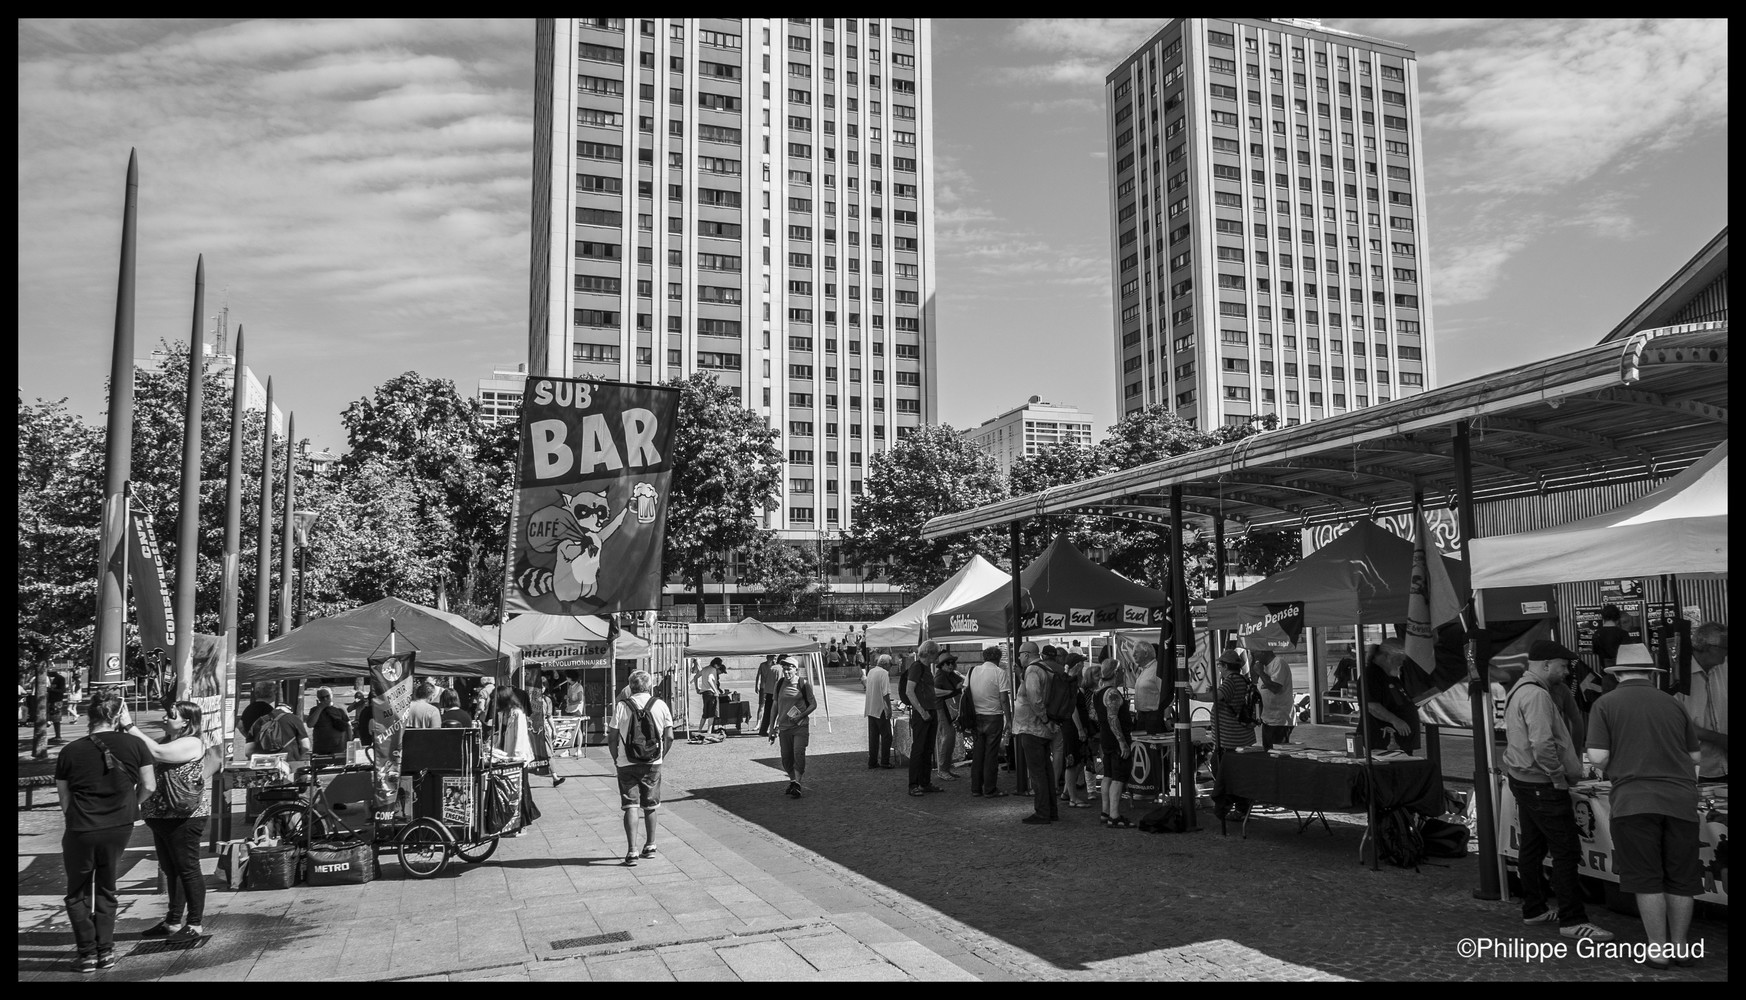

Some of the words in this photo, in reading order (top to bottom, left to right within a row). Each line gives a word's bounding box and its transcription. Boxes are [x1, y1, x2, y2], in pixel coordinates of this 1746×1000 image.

[534, 380, 599, 409] SUB'
[530, 408, 662, 479] BAR
[529, 519, 559, 537] CAFÉ
[134, 516, 151, 558] CNT
[1044, 615, 1064, 628] Sud
[1071, 611, 1093, 624] Sud
[1096, 608, 1119, 621] Sud
[1125, 608, 1147, 621] Sud
[1239, 621, 1262, 636] Libre
[1265, 604, 1299, 627] Pensée
[950, 614, 979, 632] Solidaires
[549, 659, 607, 668] RÉVOLUTIONNAIRES
[383, 708, 394, 718] AU
[314, 862, 350, 873] METRO
[1588, 850, 1608, 872] ET
